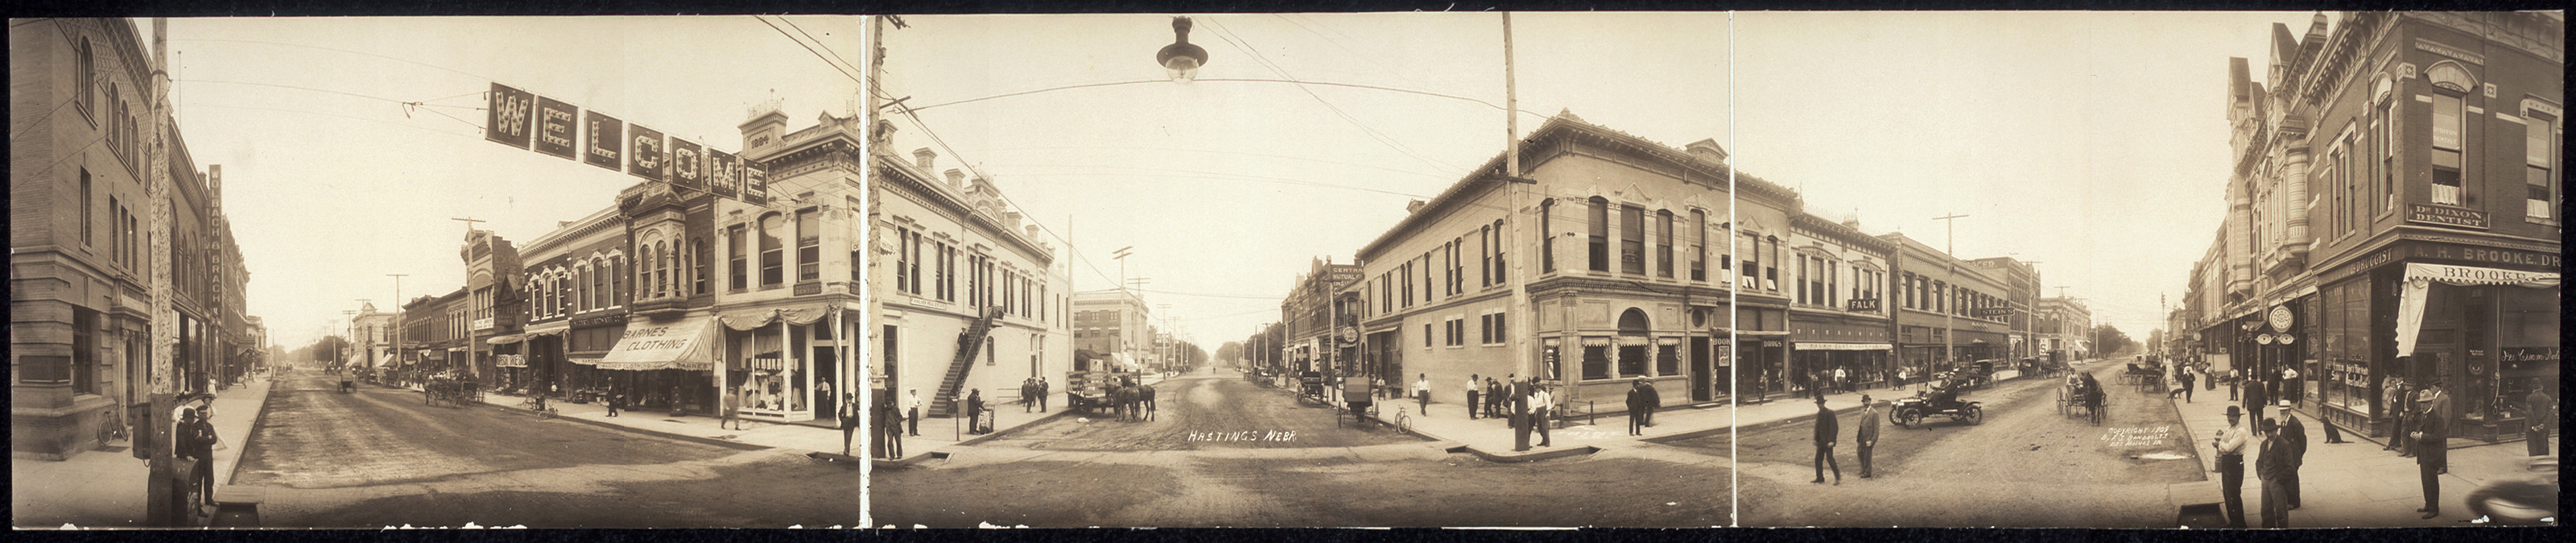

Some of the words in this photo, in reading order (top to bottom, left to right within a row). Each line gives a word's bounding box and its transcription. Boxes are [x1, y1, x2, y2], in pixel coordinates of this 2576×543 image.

[495, 91, 766, 197] WELCOME
[751, 135, 770, 149] 1884
[211, 170, 220, 237] WOLBACH
[2435, 206, 2482, 219] DIXON
[2417, 213, 2482, 226] DENTIST
[212, 256, 221, 303] BRACH
[2444, 267, 2526, 280] BROOKE
[1852, 300, 1876, 309] FALK
[623, 326, 669, 339] BARNES
[626, 338, 687, 351] CLOTHING
[1764, 340, 1782, 348] DRUGS
[2501, 350, 2516, 362] Ice
[2518, 348, 2544, 362] Cream
